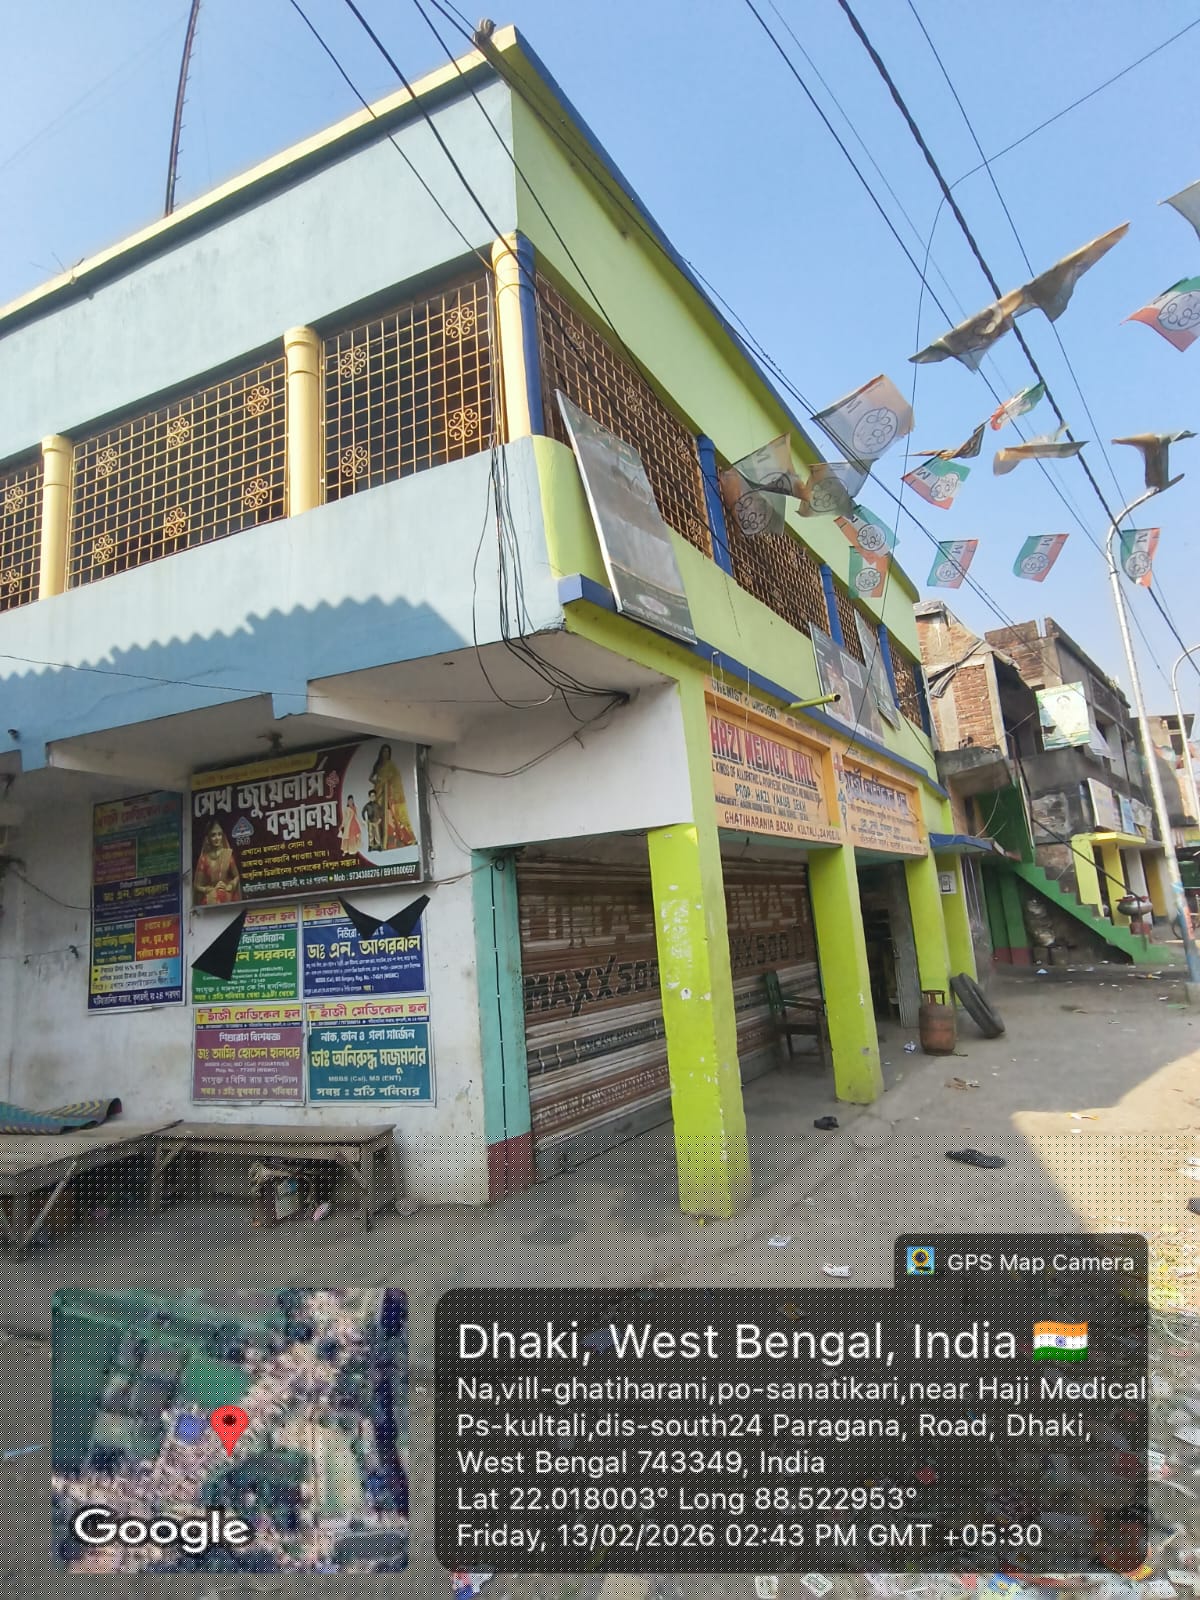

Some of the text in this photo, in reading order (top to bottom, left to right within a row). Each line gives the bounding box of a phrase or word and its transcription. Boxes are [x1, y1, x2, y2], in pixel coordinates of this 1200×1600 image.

[711, 716, 743, 764] HAZI
[744, 731, 794, 780] MEDICAL
[792, 751, 818, 790] HALL
[280, 911, 296, 921] হল
[315, 903, 341, 917] হাজী
[254, 948, 296, 961] সরকার
[307, 943, 326, 960] ডাঃ
[358, 935, 421, 955] আগরবাল
[208, 1007, 300, 1021] হাজী মেডিকেল হল
[320, 1002, 427, 1017] হাজী মেডিকেল হল
[321, 1031, 340, 1043] নাক,
[341, 1030, 357, 1041] কান
[359, 1032, 365, 1041] ও
[368, 1029, 385, 1041] গলা
[197, 1048, 209, 1060] ডাঃ
[311, 1044, 427, 1075] ডাঃ অনিরুদ্ধ মজুমদার
[316, 1087, 341, 1097] সময়
[353, 1084, 376, 1096] প্রতি
[378, 1084, 420, 1097] শনিবার
